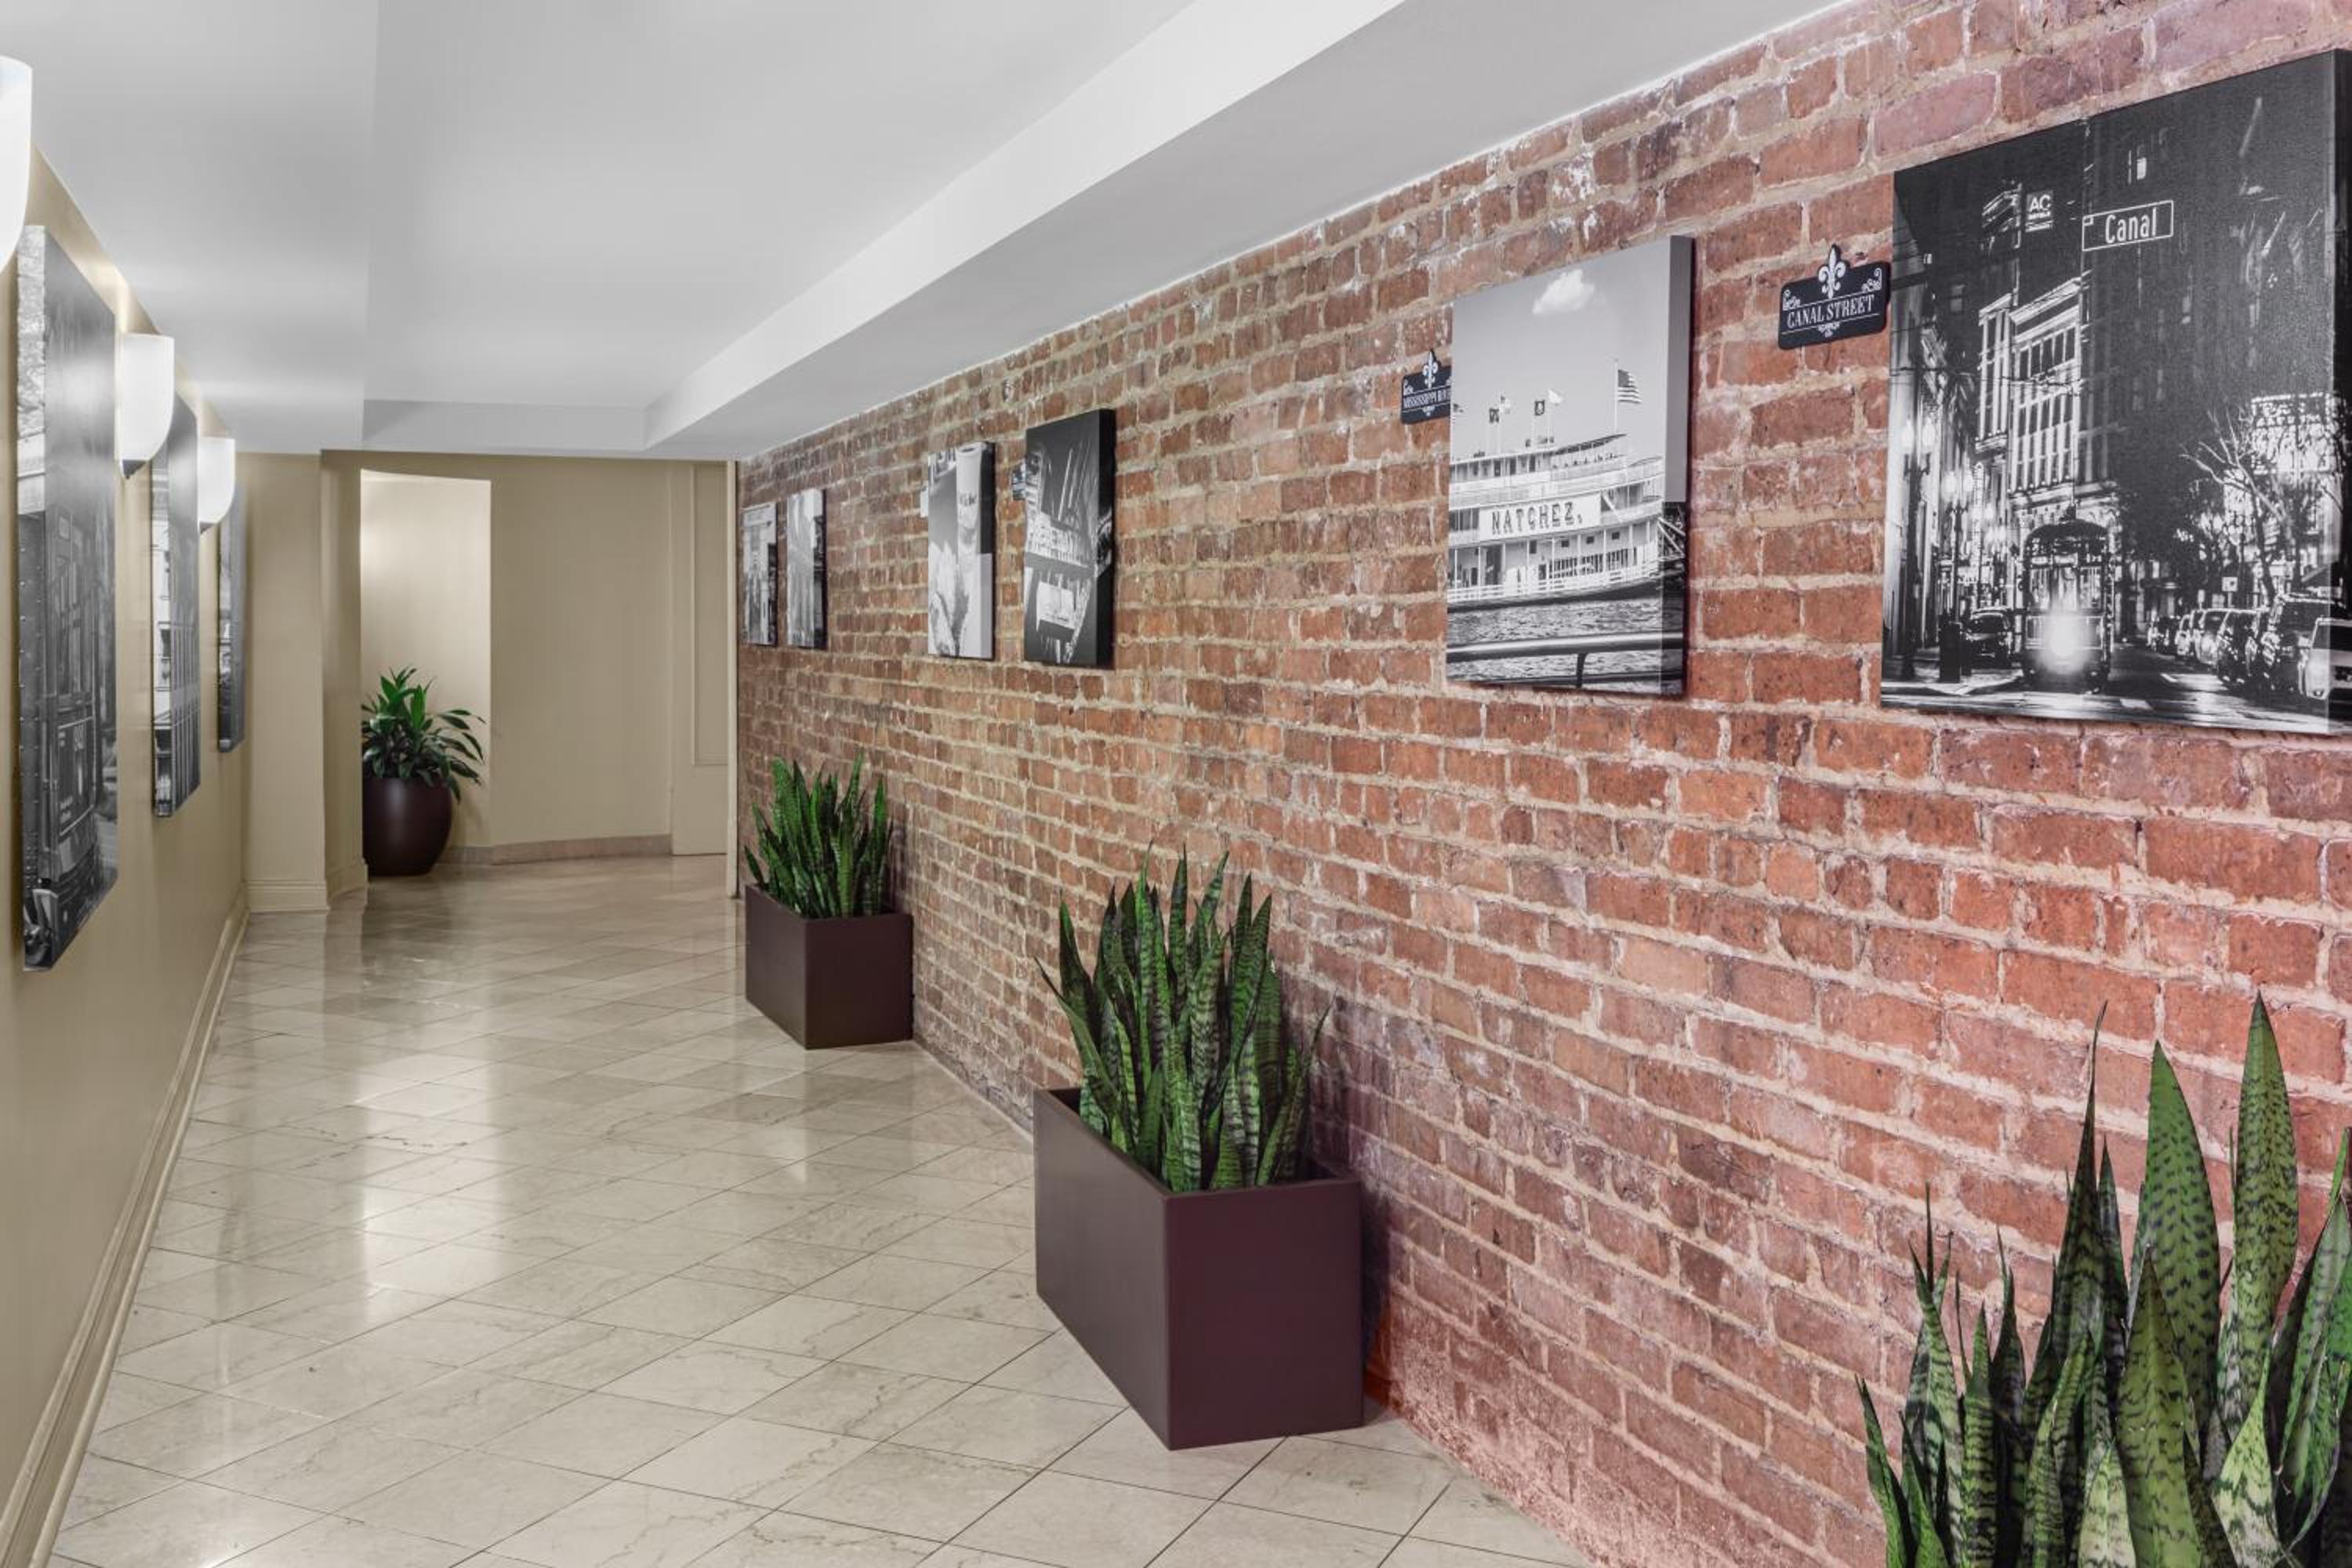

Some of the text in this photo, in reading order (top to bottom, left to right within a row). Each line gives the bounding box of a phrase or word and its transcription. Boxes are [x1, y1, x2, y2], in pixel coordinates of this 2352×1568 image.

[2029, 194, 2052, 212] AC
[2105, 206, 2157, 244] Canal
[1788, 294, 1875, 328] CANAL STREET
